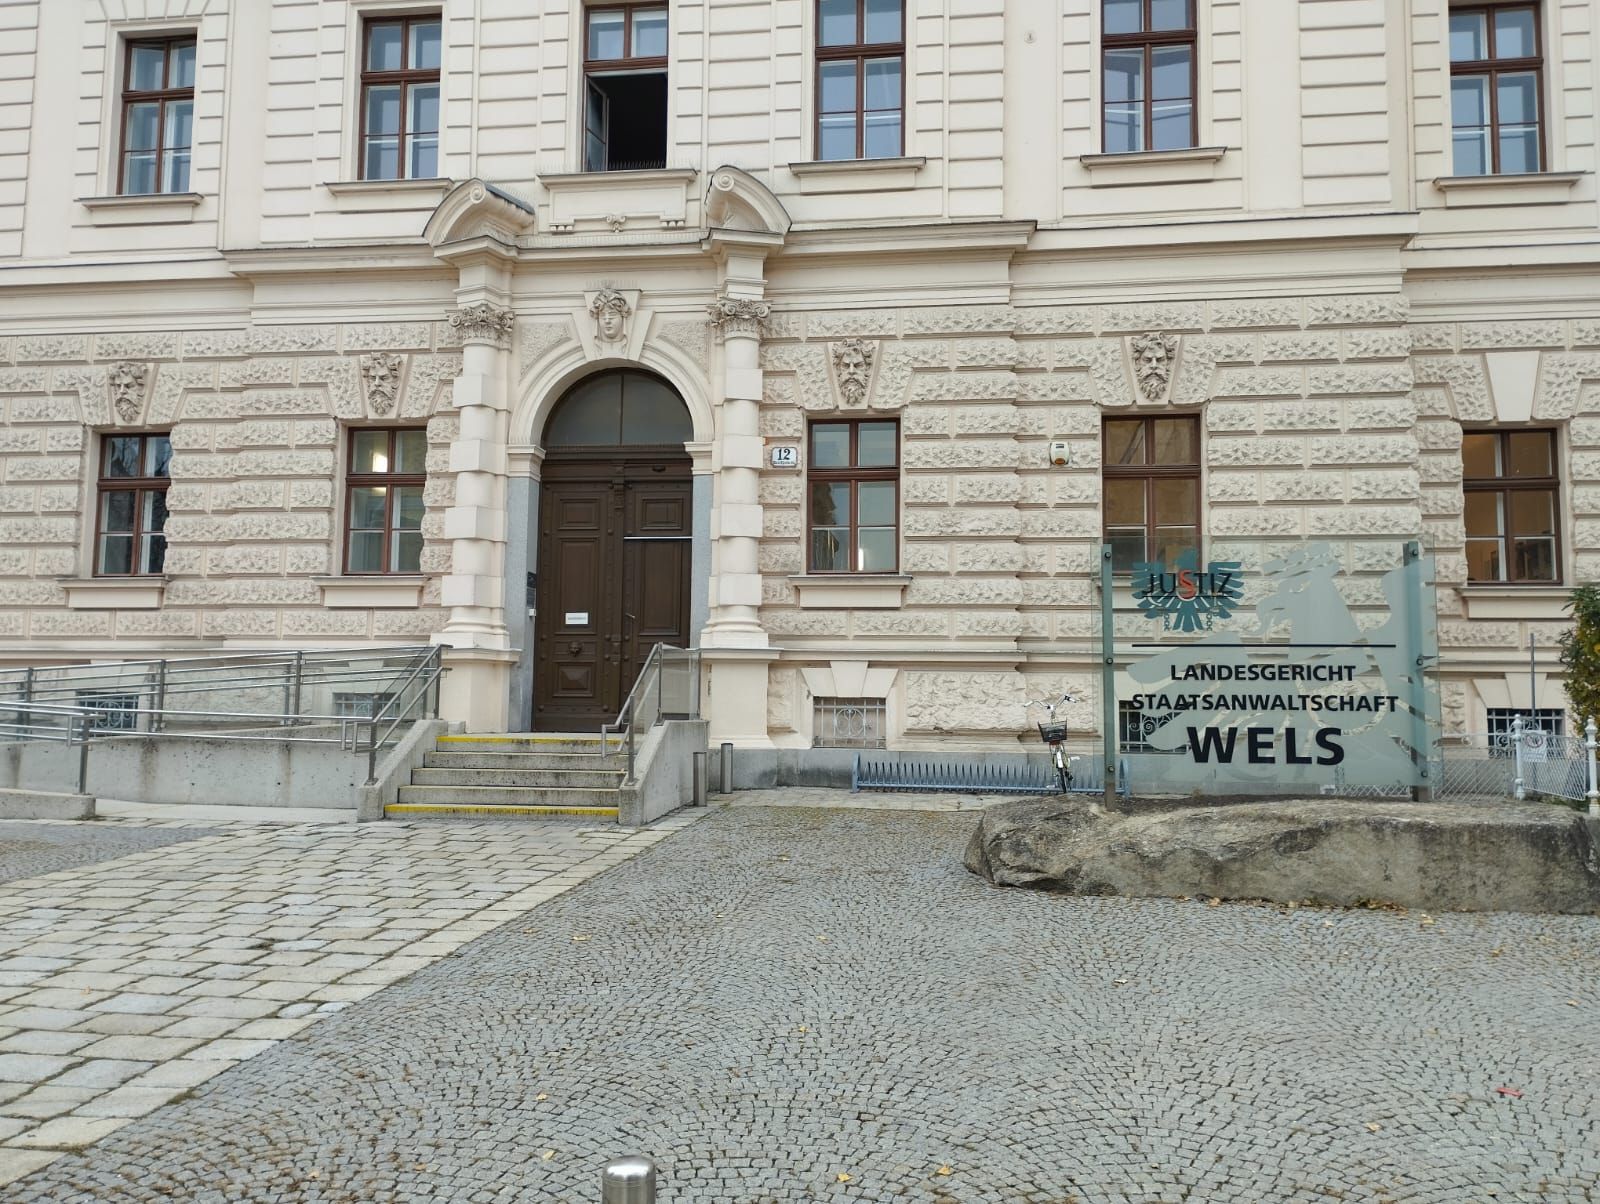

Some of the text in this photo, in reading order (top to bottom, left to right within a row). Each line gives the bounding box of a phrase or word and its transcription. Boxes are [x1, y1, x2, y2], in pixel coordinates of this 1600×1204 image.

[777, 448, 791, 461] 12
[1170, 664, 1356, 682] LANDESGERICHT
[1132, 694, 1399, 713] STAATSANWALTSCHAFT
[1187, 727, 1345, 766] WELS
